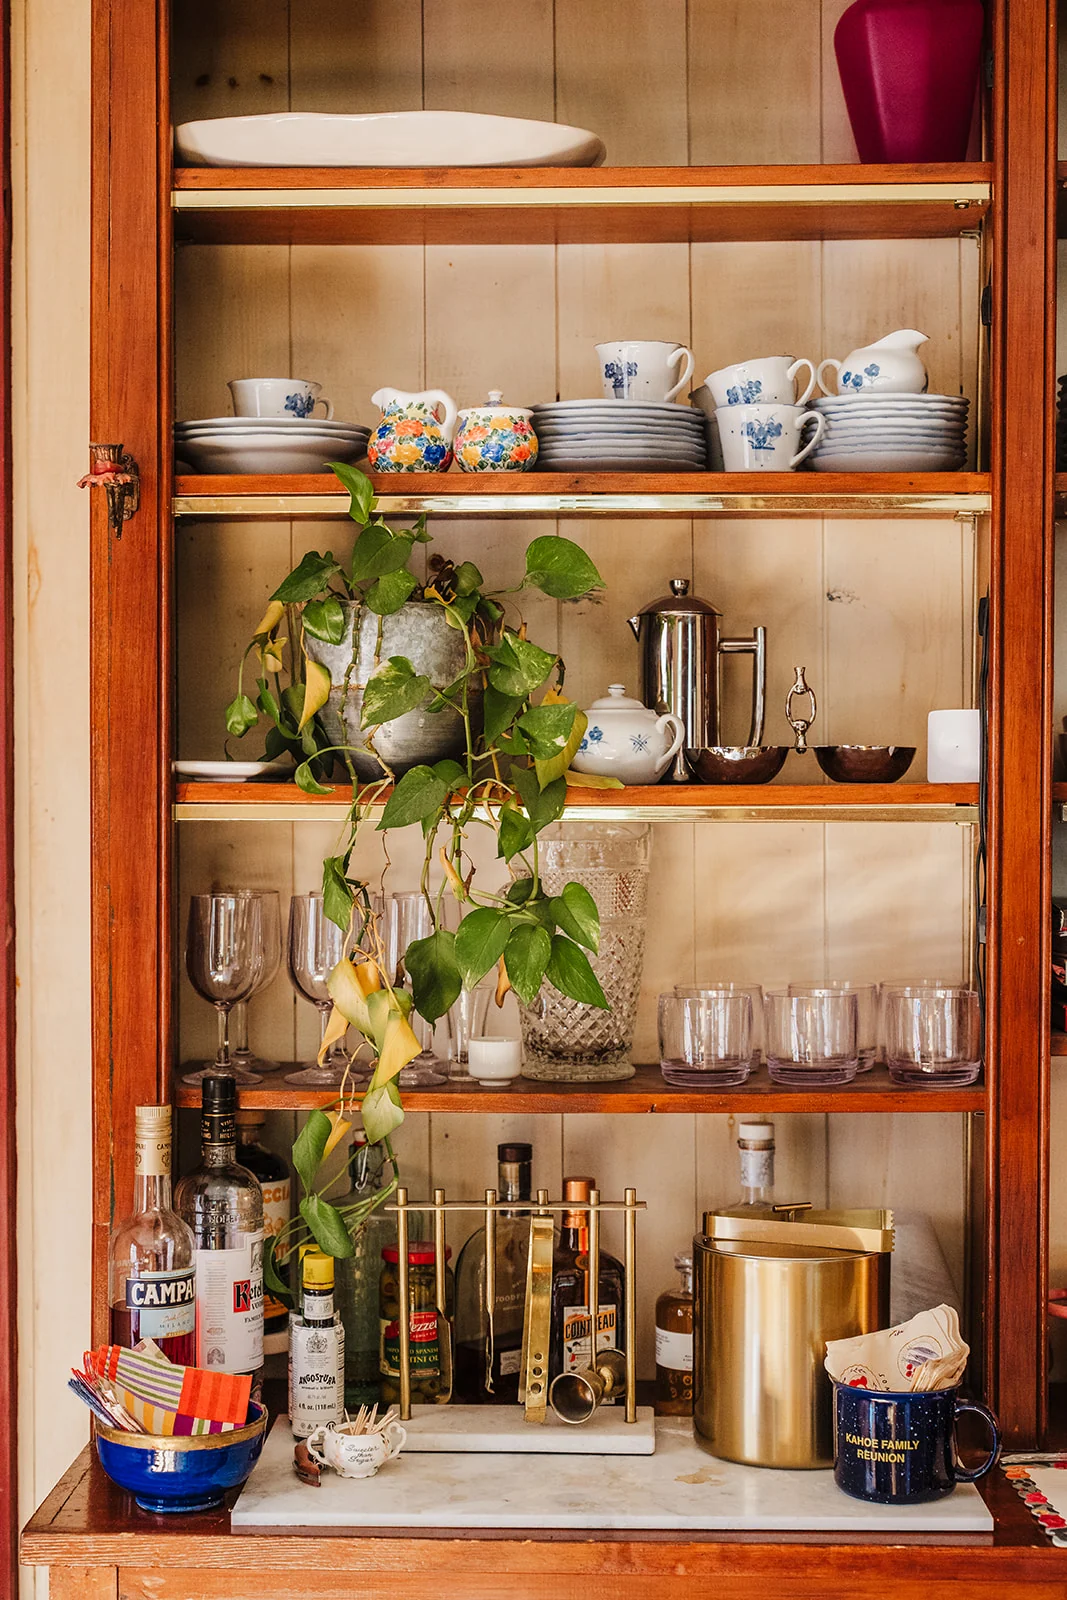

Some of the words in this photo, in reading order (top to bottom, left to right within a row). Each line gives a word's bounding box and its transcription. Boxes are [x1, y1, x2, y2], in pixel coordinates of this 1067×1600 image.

[565, 1312, 614, 1339] COINTEAU
[299, 1373, 336, 1384] ANGOSTURA
[845, 1432, 879, 1449] KAHOE
[881, 1440, 920, 1450] FAMILY
[345, 1444, 379, 1452] Sweeter
[348, 1456, 376, 1465] Sugar
[357, 1451, 372, 1459] than
[857, 1448, 905, 1463] REUNION
